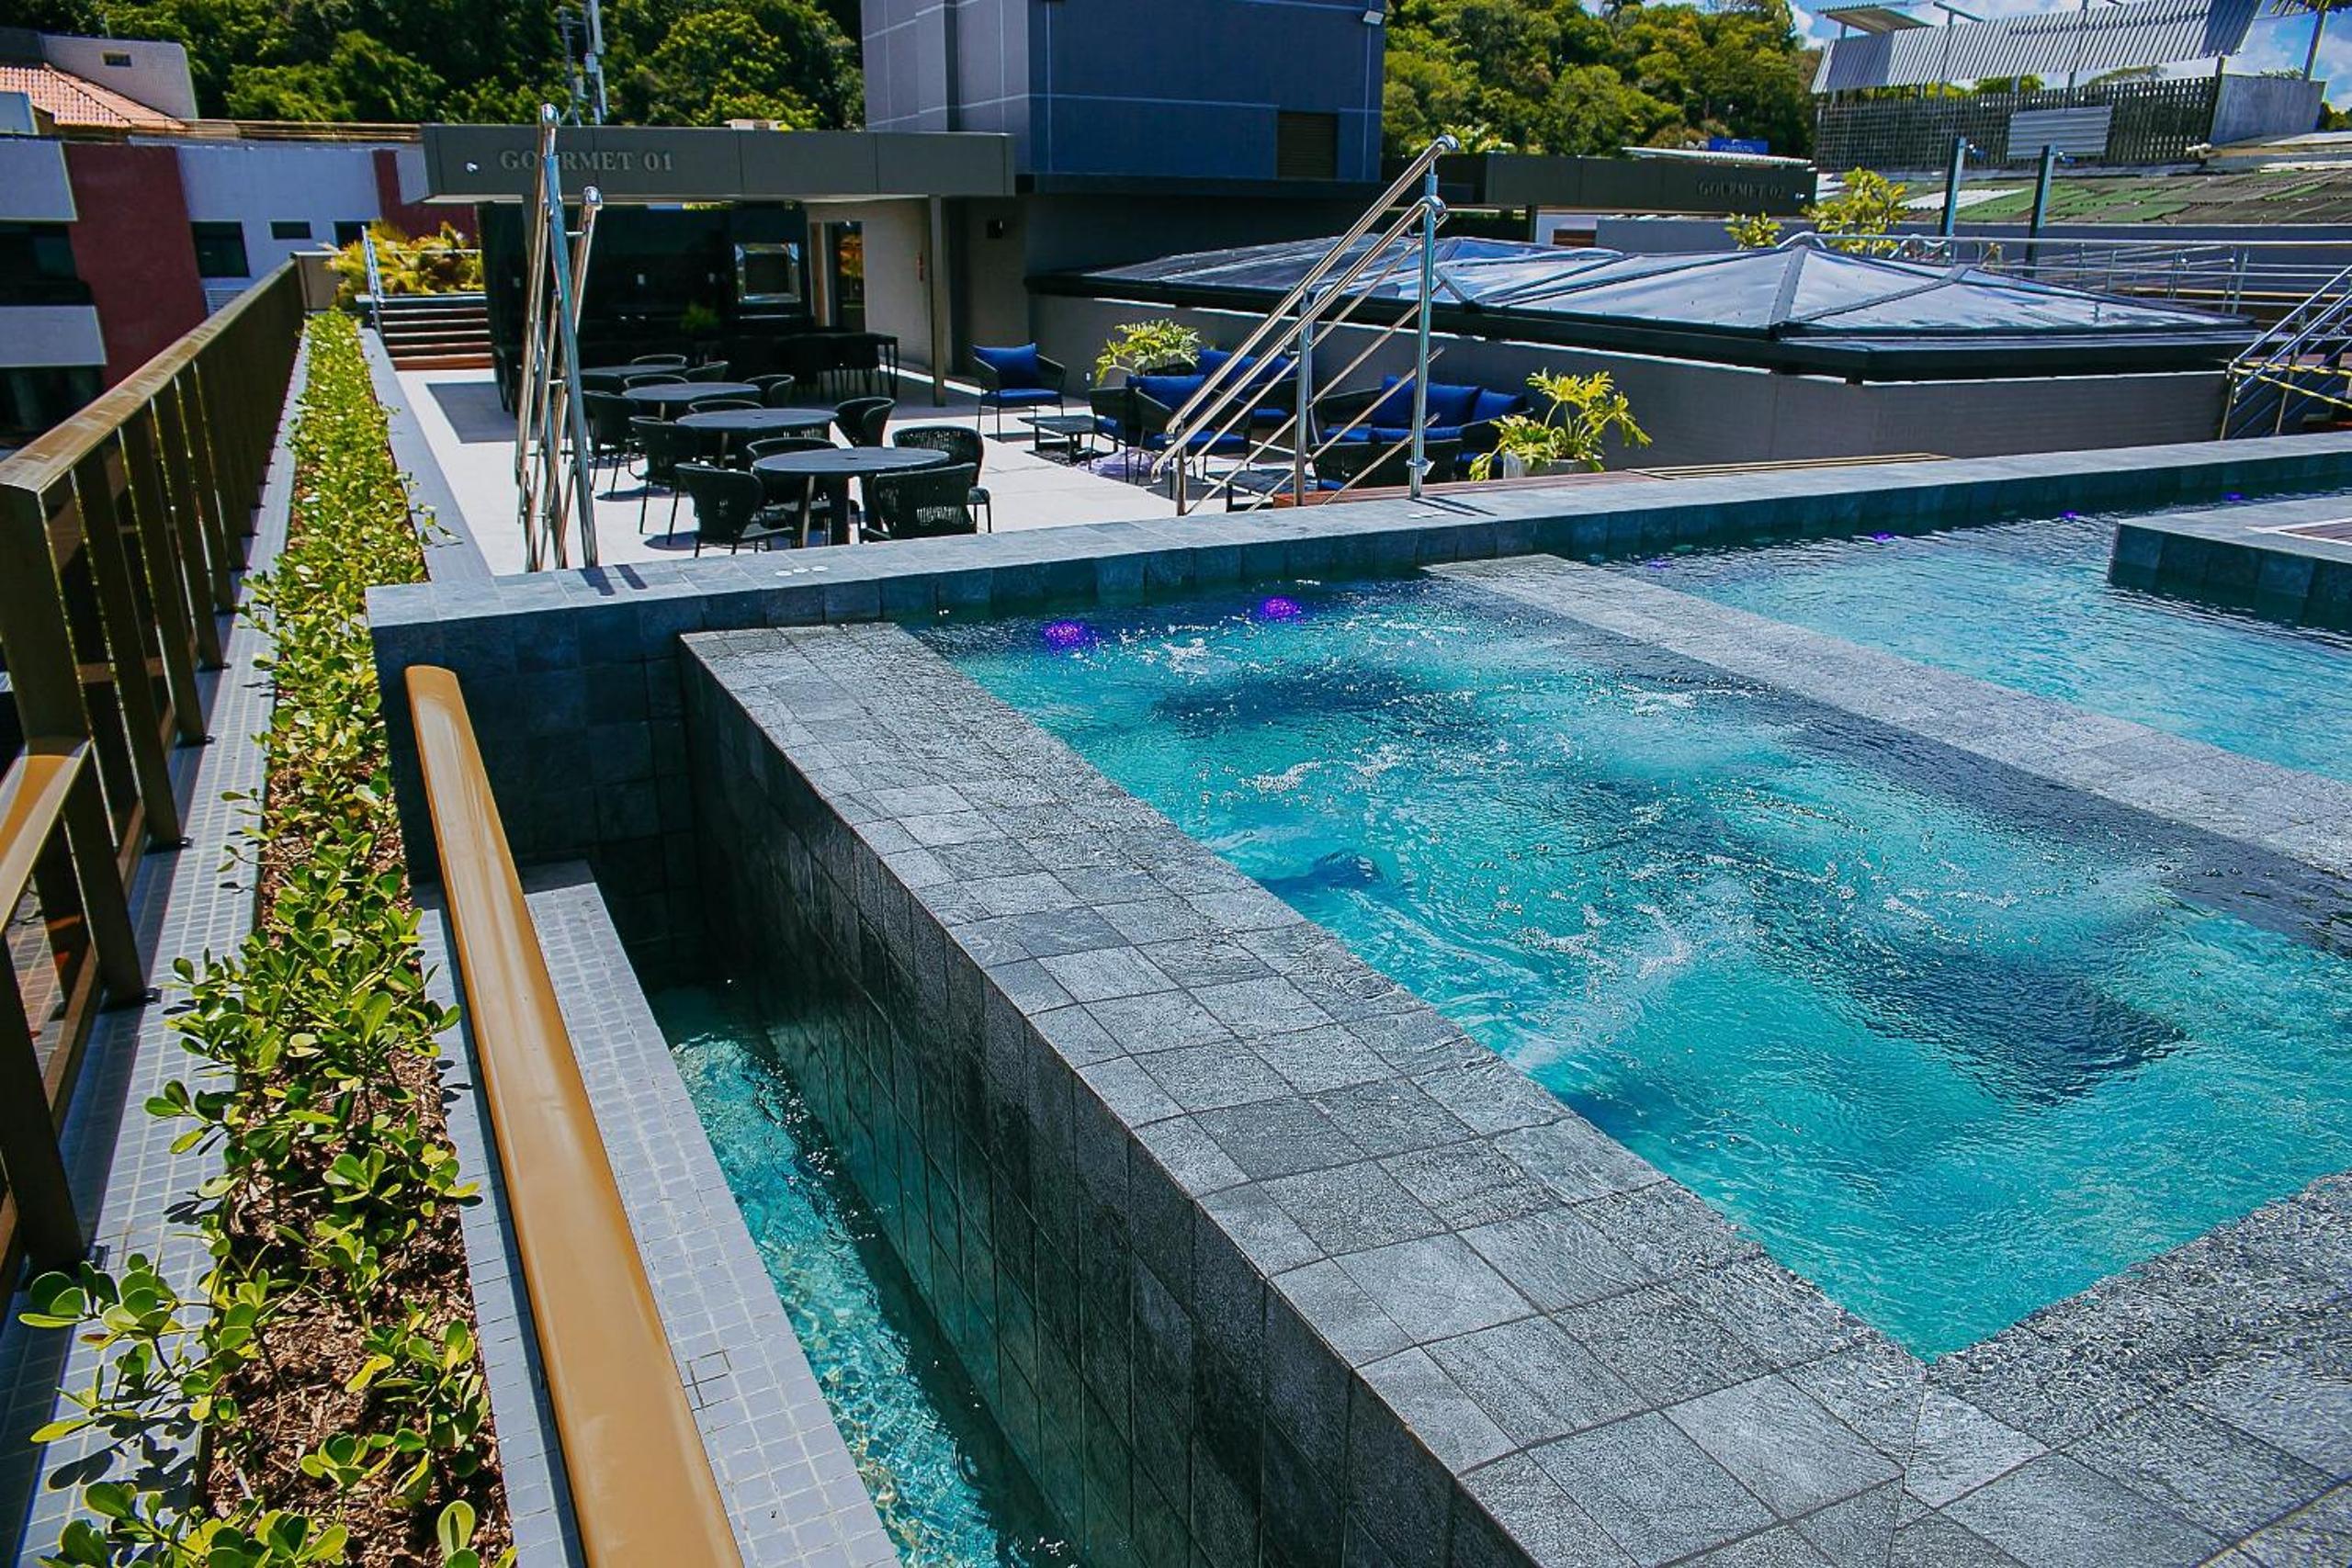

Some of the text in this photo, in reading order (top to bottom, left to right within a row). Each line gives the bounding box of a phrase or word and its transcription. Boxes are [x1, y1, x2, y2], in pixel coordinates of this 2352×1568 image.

[500, 151, 673, 171] GORMET 01
[1699, 182, 1785, 199] GOURMET 02
